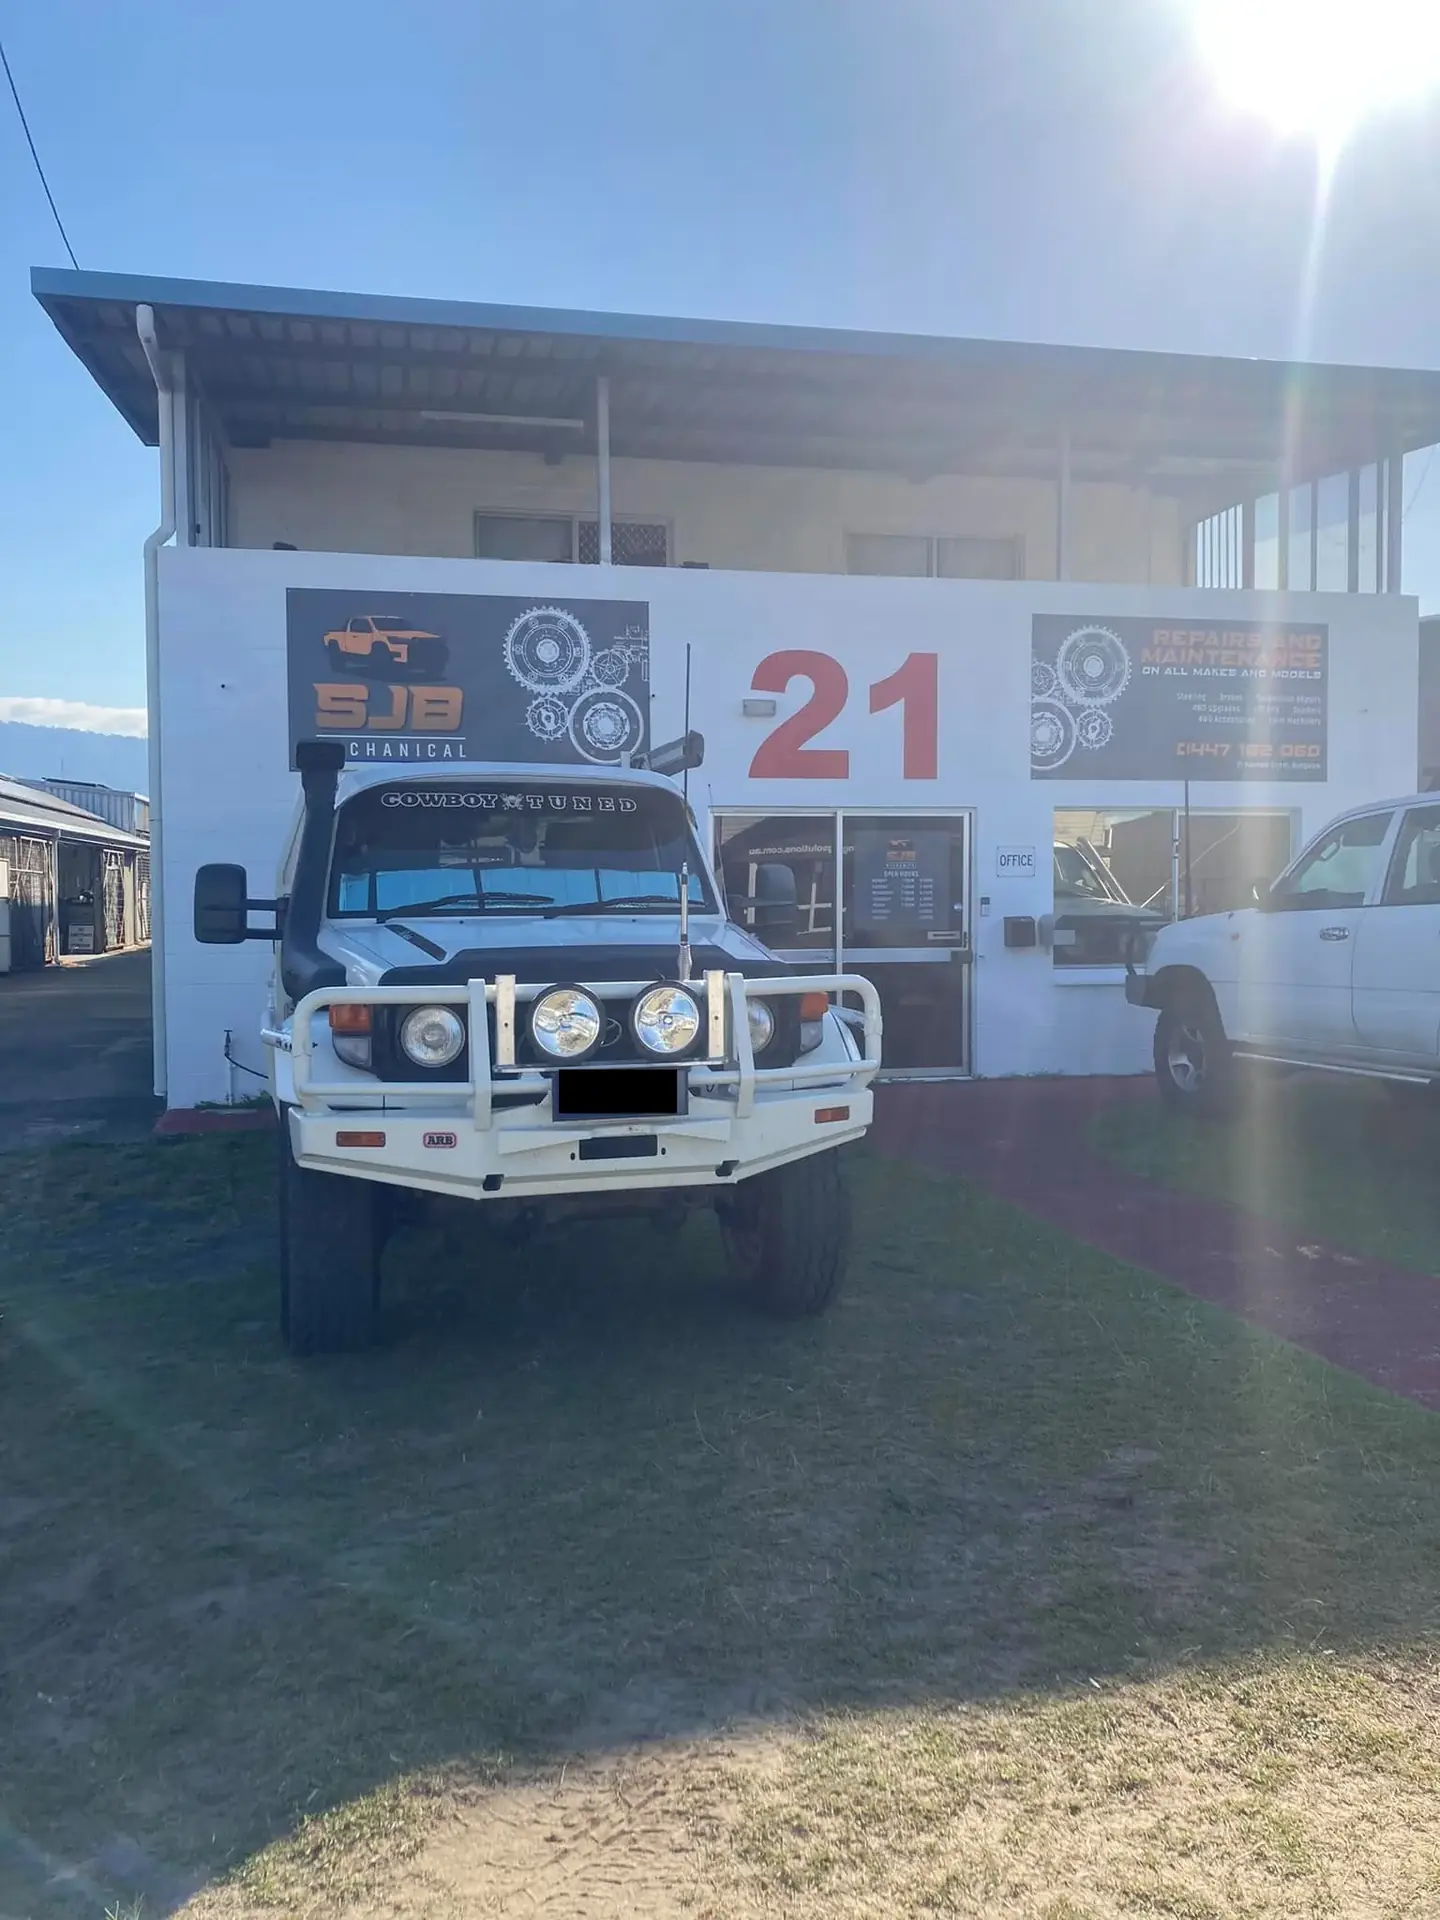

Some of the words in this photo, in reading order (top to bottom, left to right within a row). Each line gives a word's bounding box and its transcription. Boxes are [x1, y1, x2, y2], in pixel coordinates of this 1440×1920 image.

[1153, 628, 1262, 648] REPAIRS
[1275, 631, 1323, 651] AND
[1141, 648, 1323, 668] MAINTENANCE
[1142, 666, 1160, 676] ON
[1163, 666, 1189, 677] ALL
[1192, 667, 1237, 678] MAKES
[1241, 668, 1267, 679] AND
[1271, 669, 1322, 680] MODELS
[313, 683, 464, 732] SJB
[748, 649, 938, 780] 21
[349, 741, 467, 758] CHANICAL
[380, 792, 499, 809] COWBOY
[525, 794, 638, 812] TUNED
[999, 854, 1034, 867] OFFICE
[427, 1134, 454, 1146] ARB
